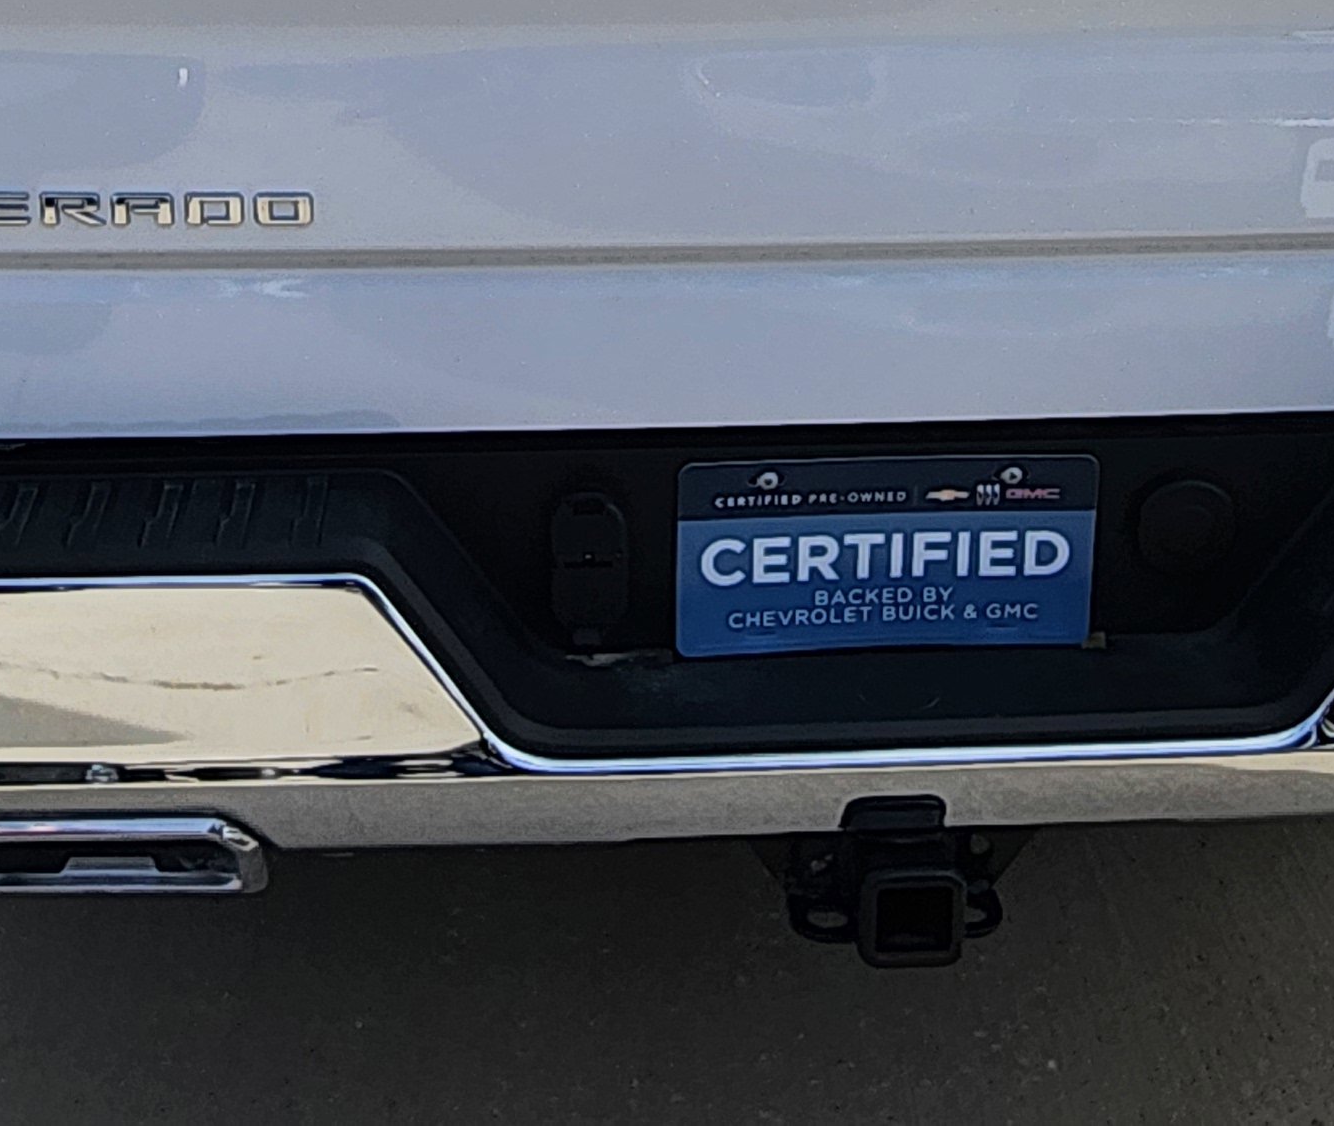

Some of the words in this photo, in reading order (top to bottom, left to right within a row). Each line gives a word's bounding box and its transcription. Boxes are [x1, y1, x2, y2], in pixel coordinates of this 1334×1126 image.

[714, 493, 803, 509] CERTIFIED
[807, 490, 907, 504] PRE-OWNED
[1005, 487, 1061, 500] GMC
[700, 529, 1071, 587] CERTIFIED
[814, 587, 913, 606] BACKED
[922, 586, 954, 602] BY
[728, 606, 873, 629] CHEVROLET
[881, 604, 956, 622] BUICK
[963, 604, 978, 619] &
[986, 603, 1039, 620] GMC
